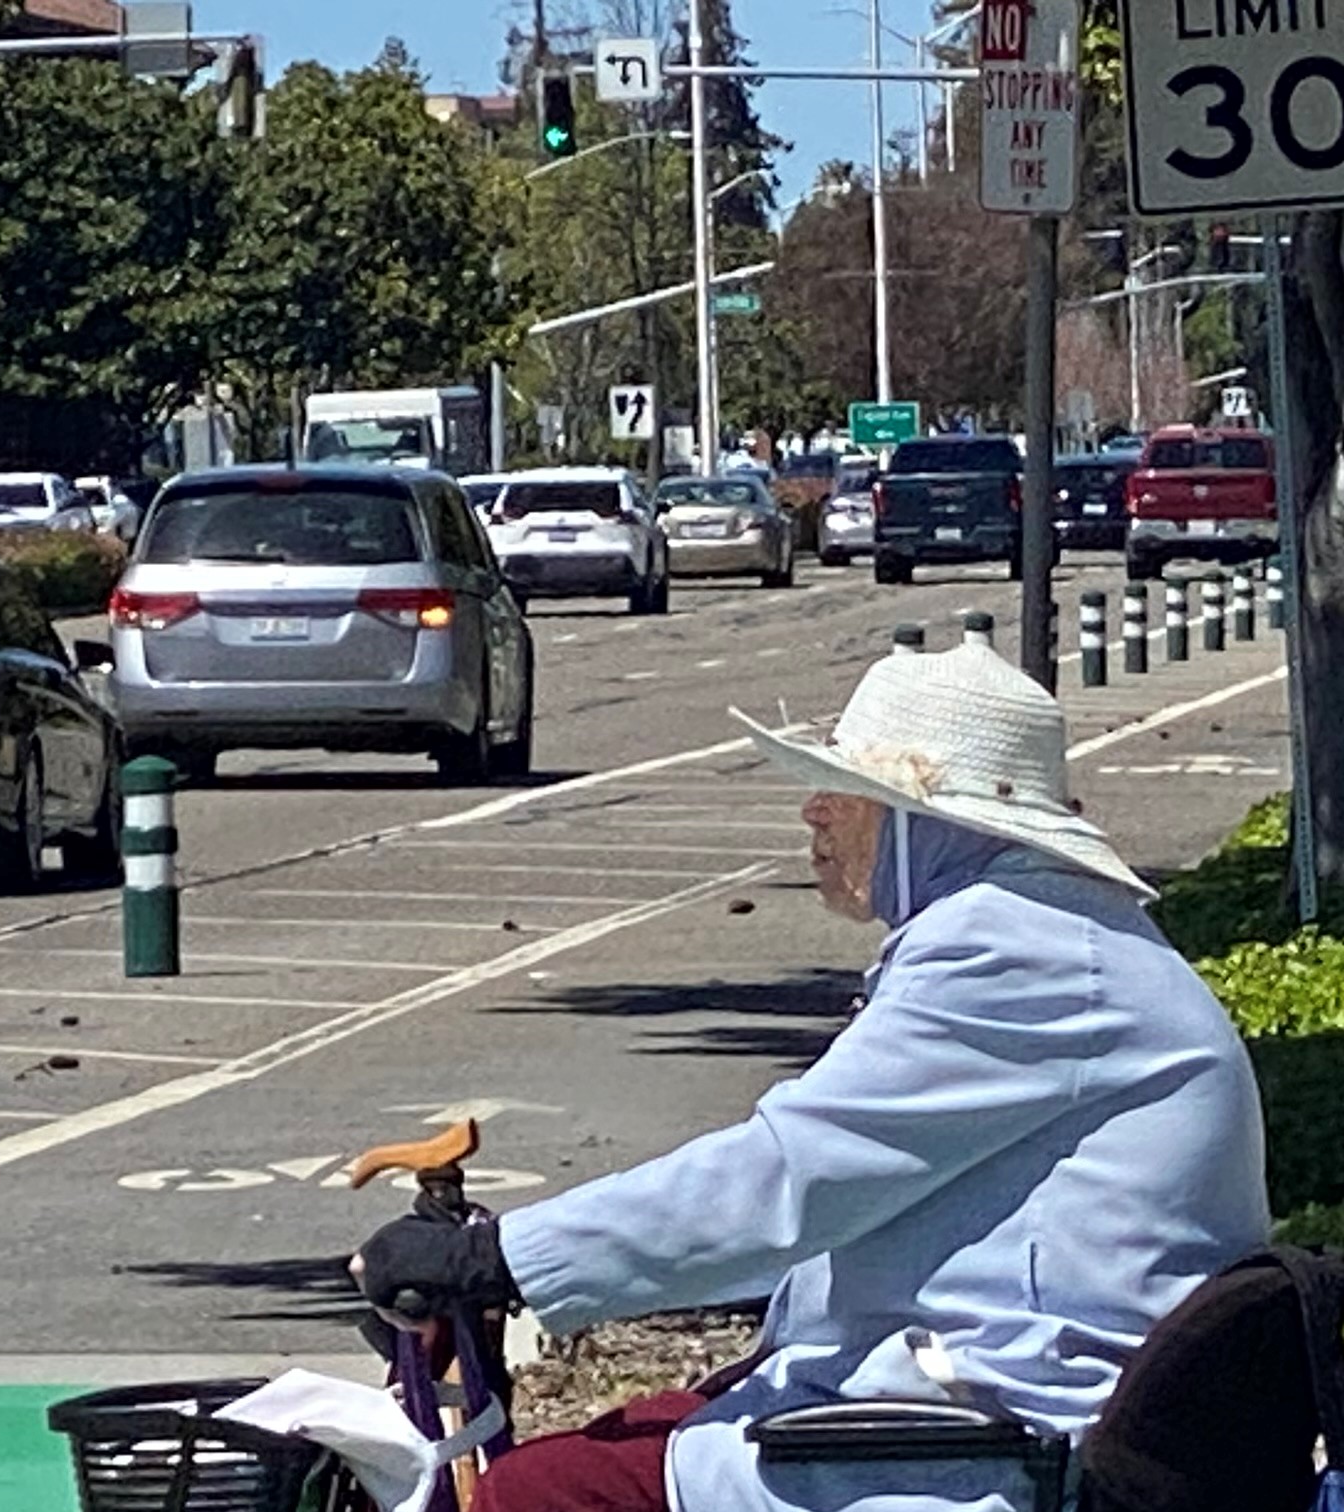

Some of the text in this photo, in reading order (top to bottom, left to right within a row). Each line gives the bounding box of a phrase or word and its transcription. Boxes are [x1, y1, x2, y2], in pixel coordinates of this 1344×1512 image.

[987, 4, 1021, 51] NO
[984, 69, 1075, 110] STOPPING
[1010, 120, 1047, 150] ANY
[1010, 158, 1047, 189] TIME
